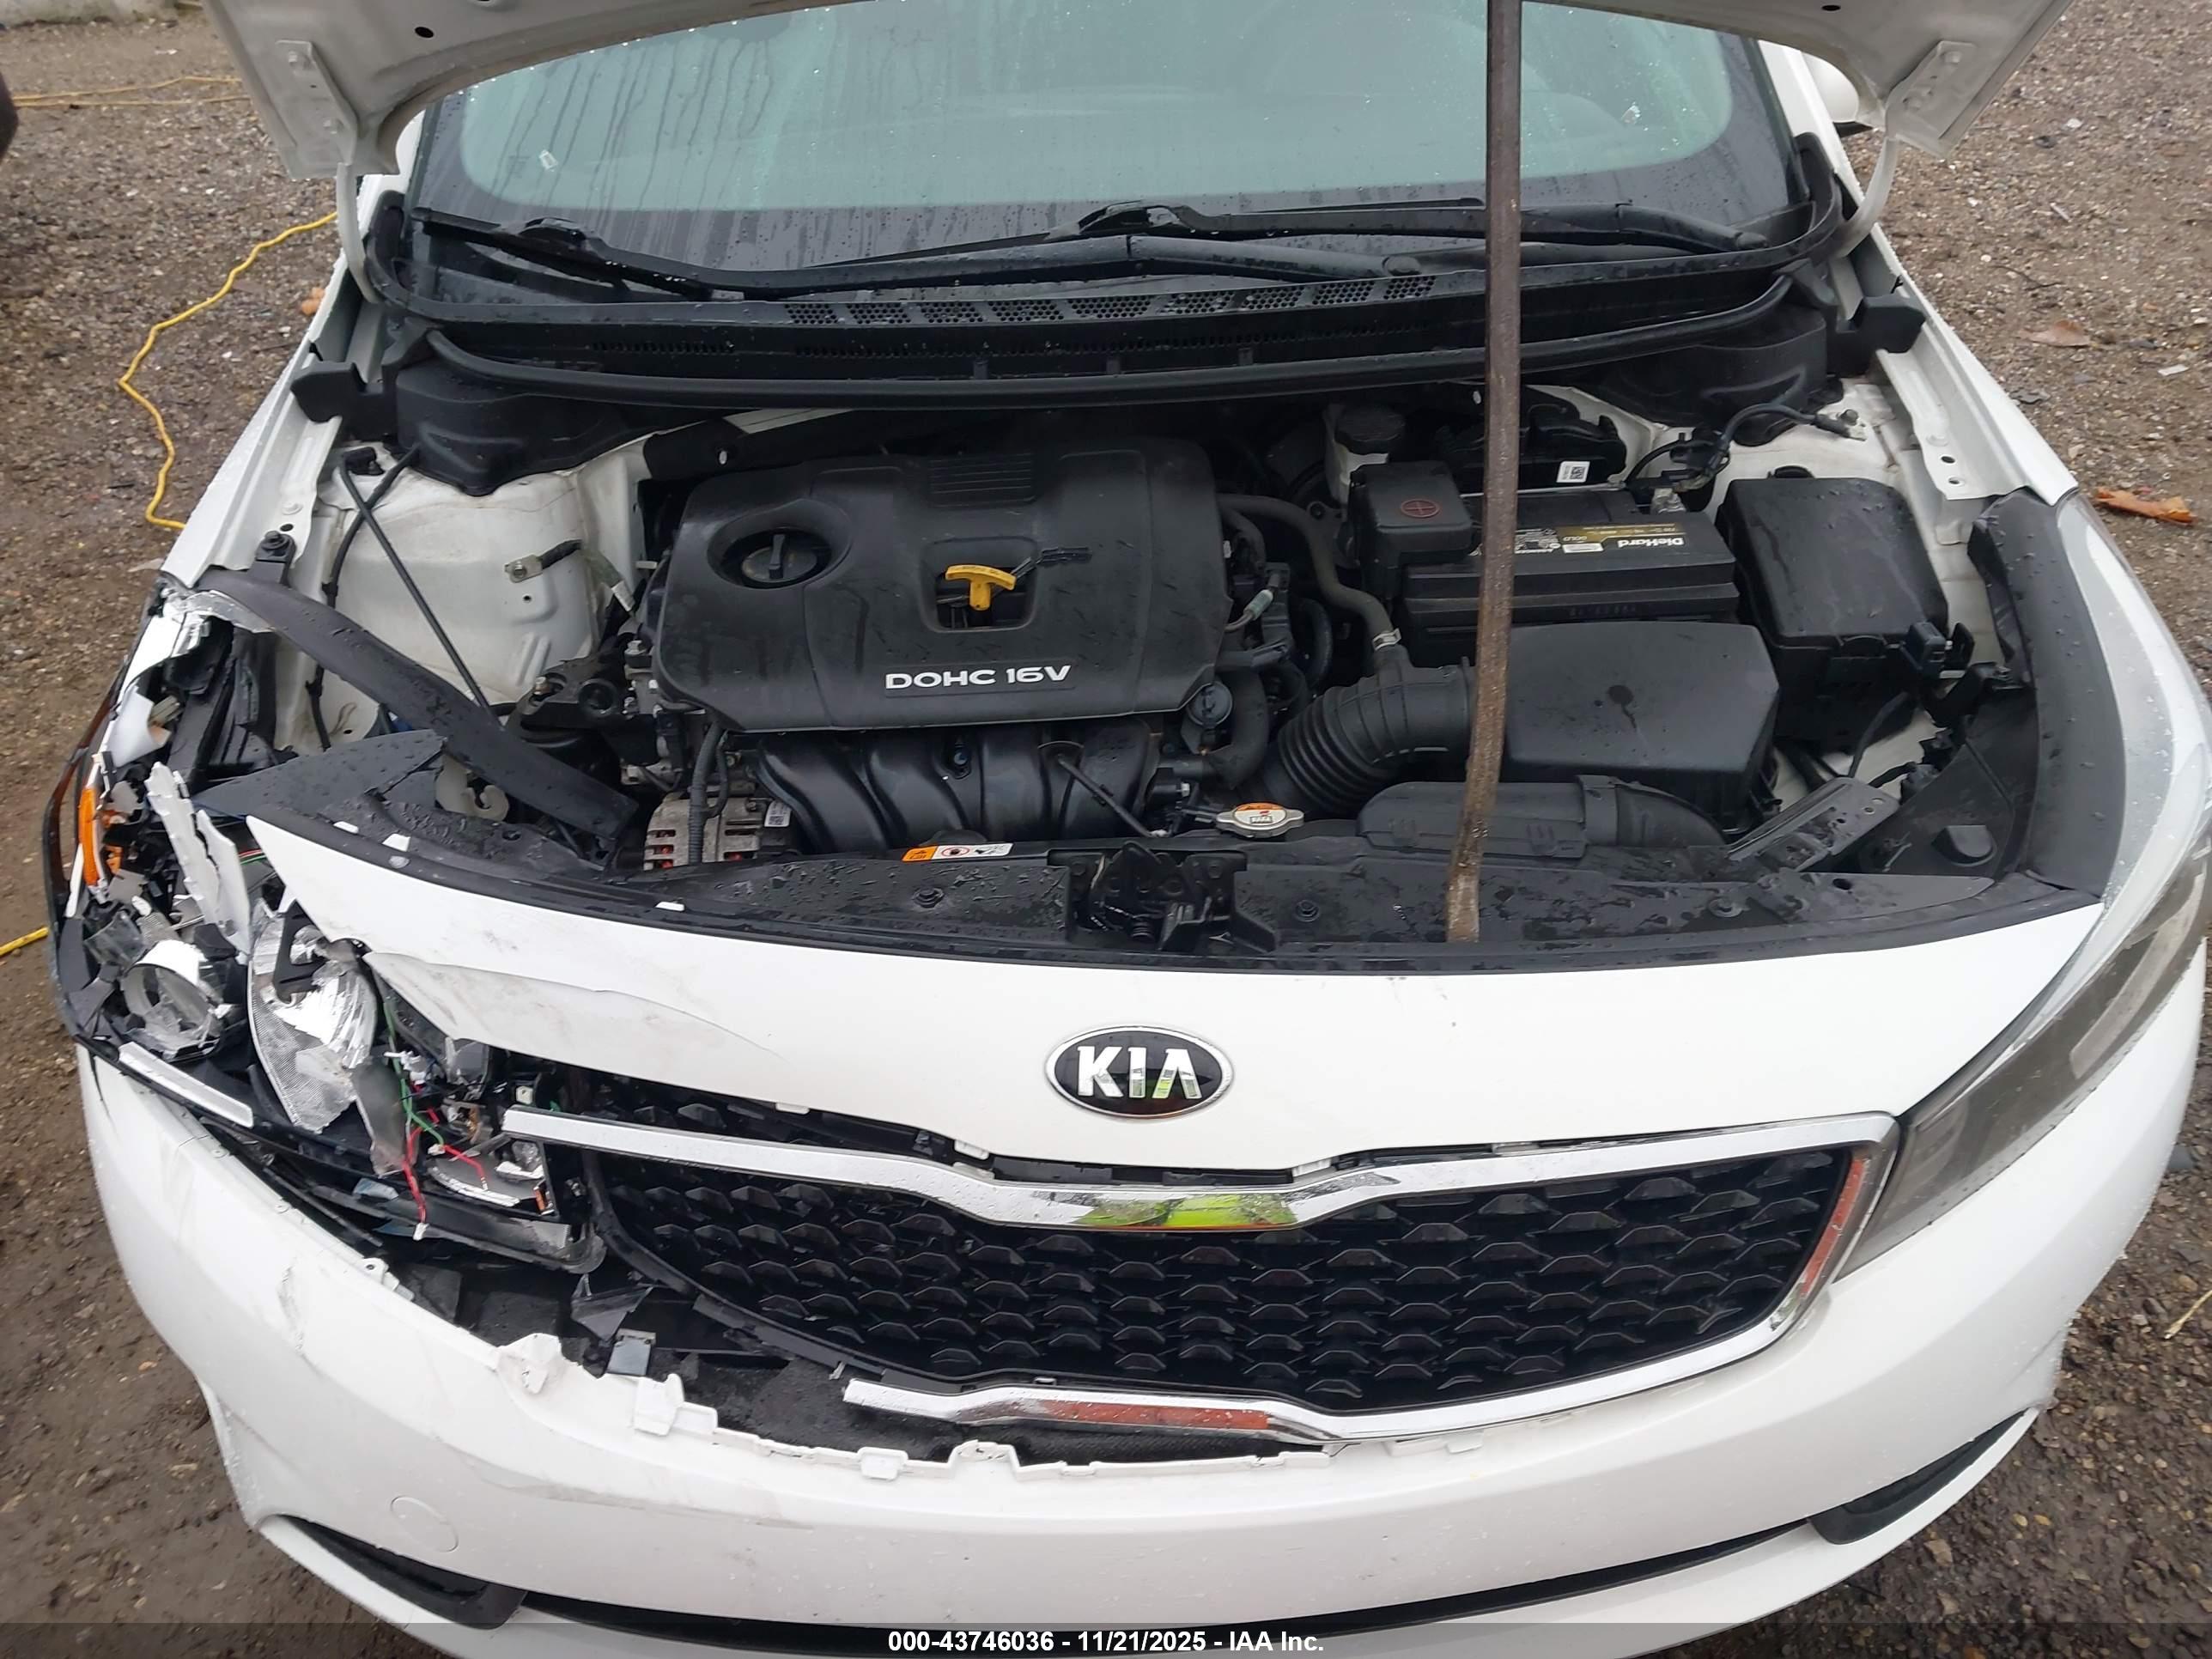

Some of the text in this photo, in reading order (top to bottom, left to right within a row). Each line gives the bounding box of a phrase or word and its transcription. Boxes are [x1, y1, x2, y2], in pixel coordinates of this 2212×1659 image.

[1617, 537, 1684, 549] DieHard
[885, 665, 1072, 690] DOHC 16V
[1077, 1045, 1202, 1099] KIA
